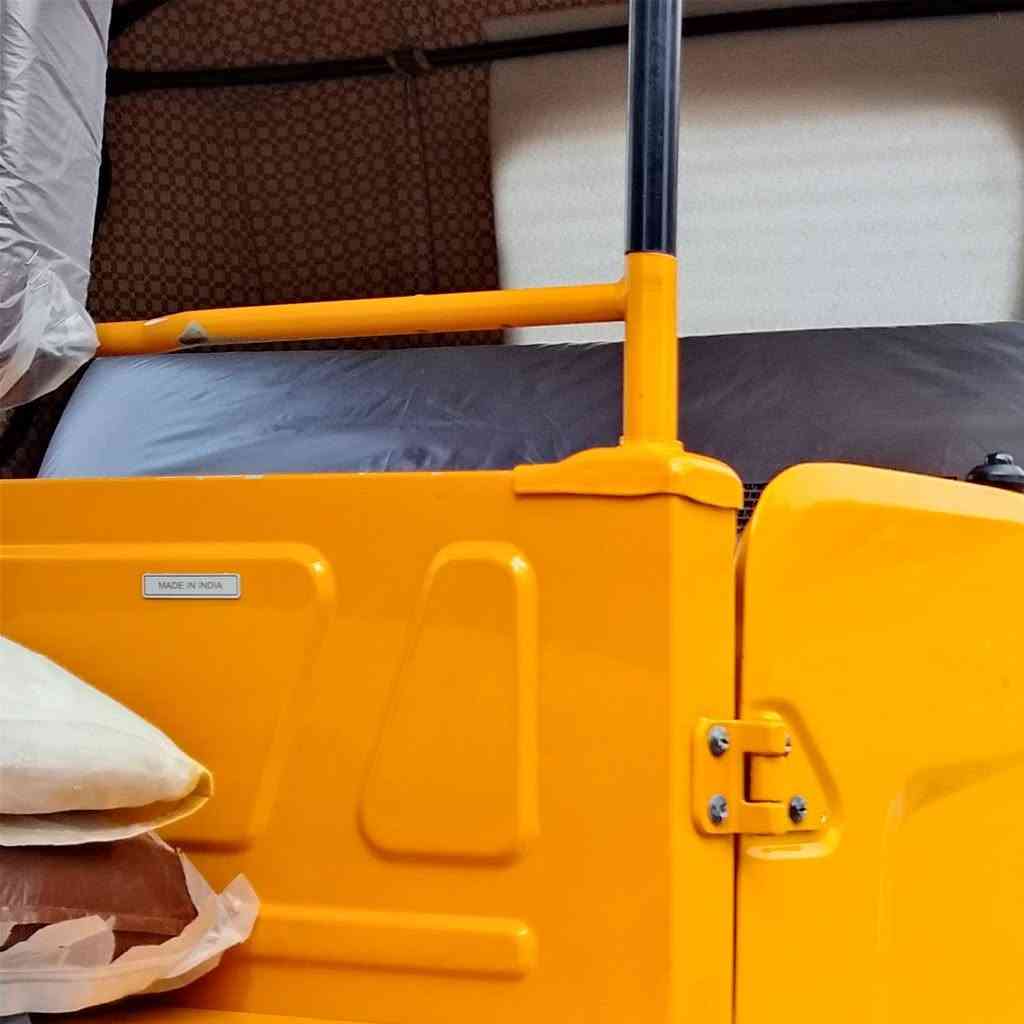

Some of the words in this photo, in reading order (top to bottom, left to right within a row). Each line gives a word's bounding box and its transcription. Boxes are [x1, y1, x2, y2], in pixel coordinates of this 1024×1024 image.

[158, 581, 184, 591] MADE
[187, 581, 195, 591] IN
[199, 581, 223, 591] INDIA
